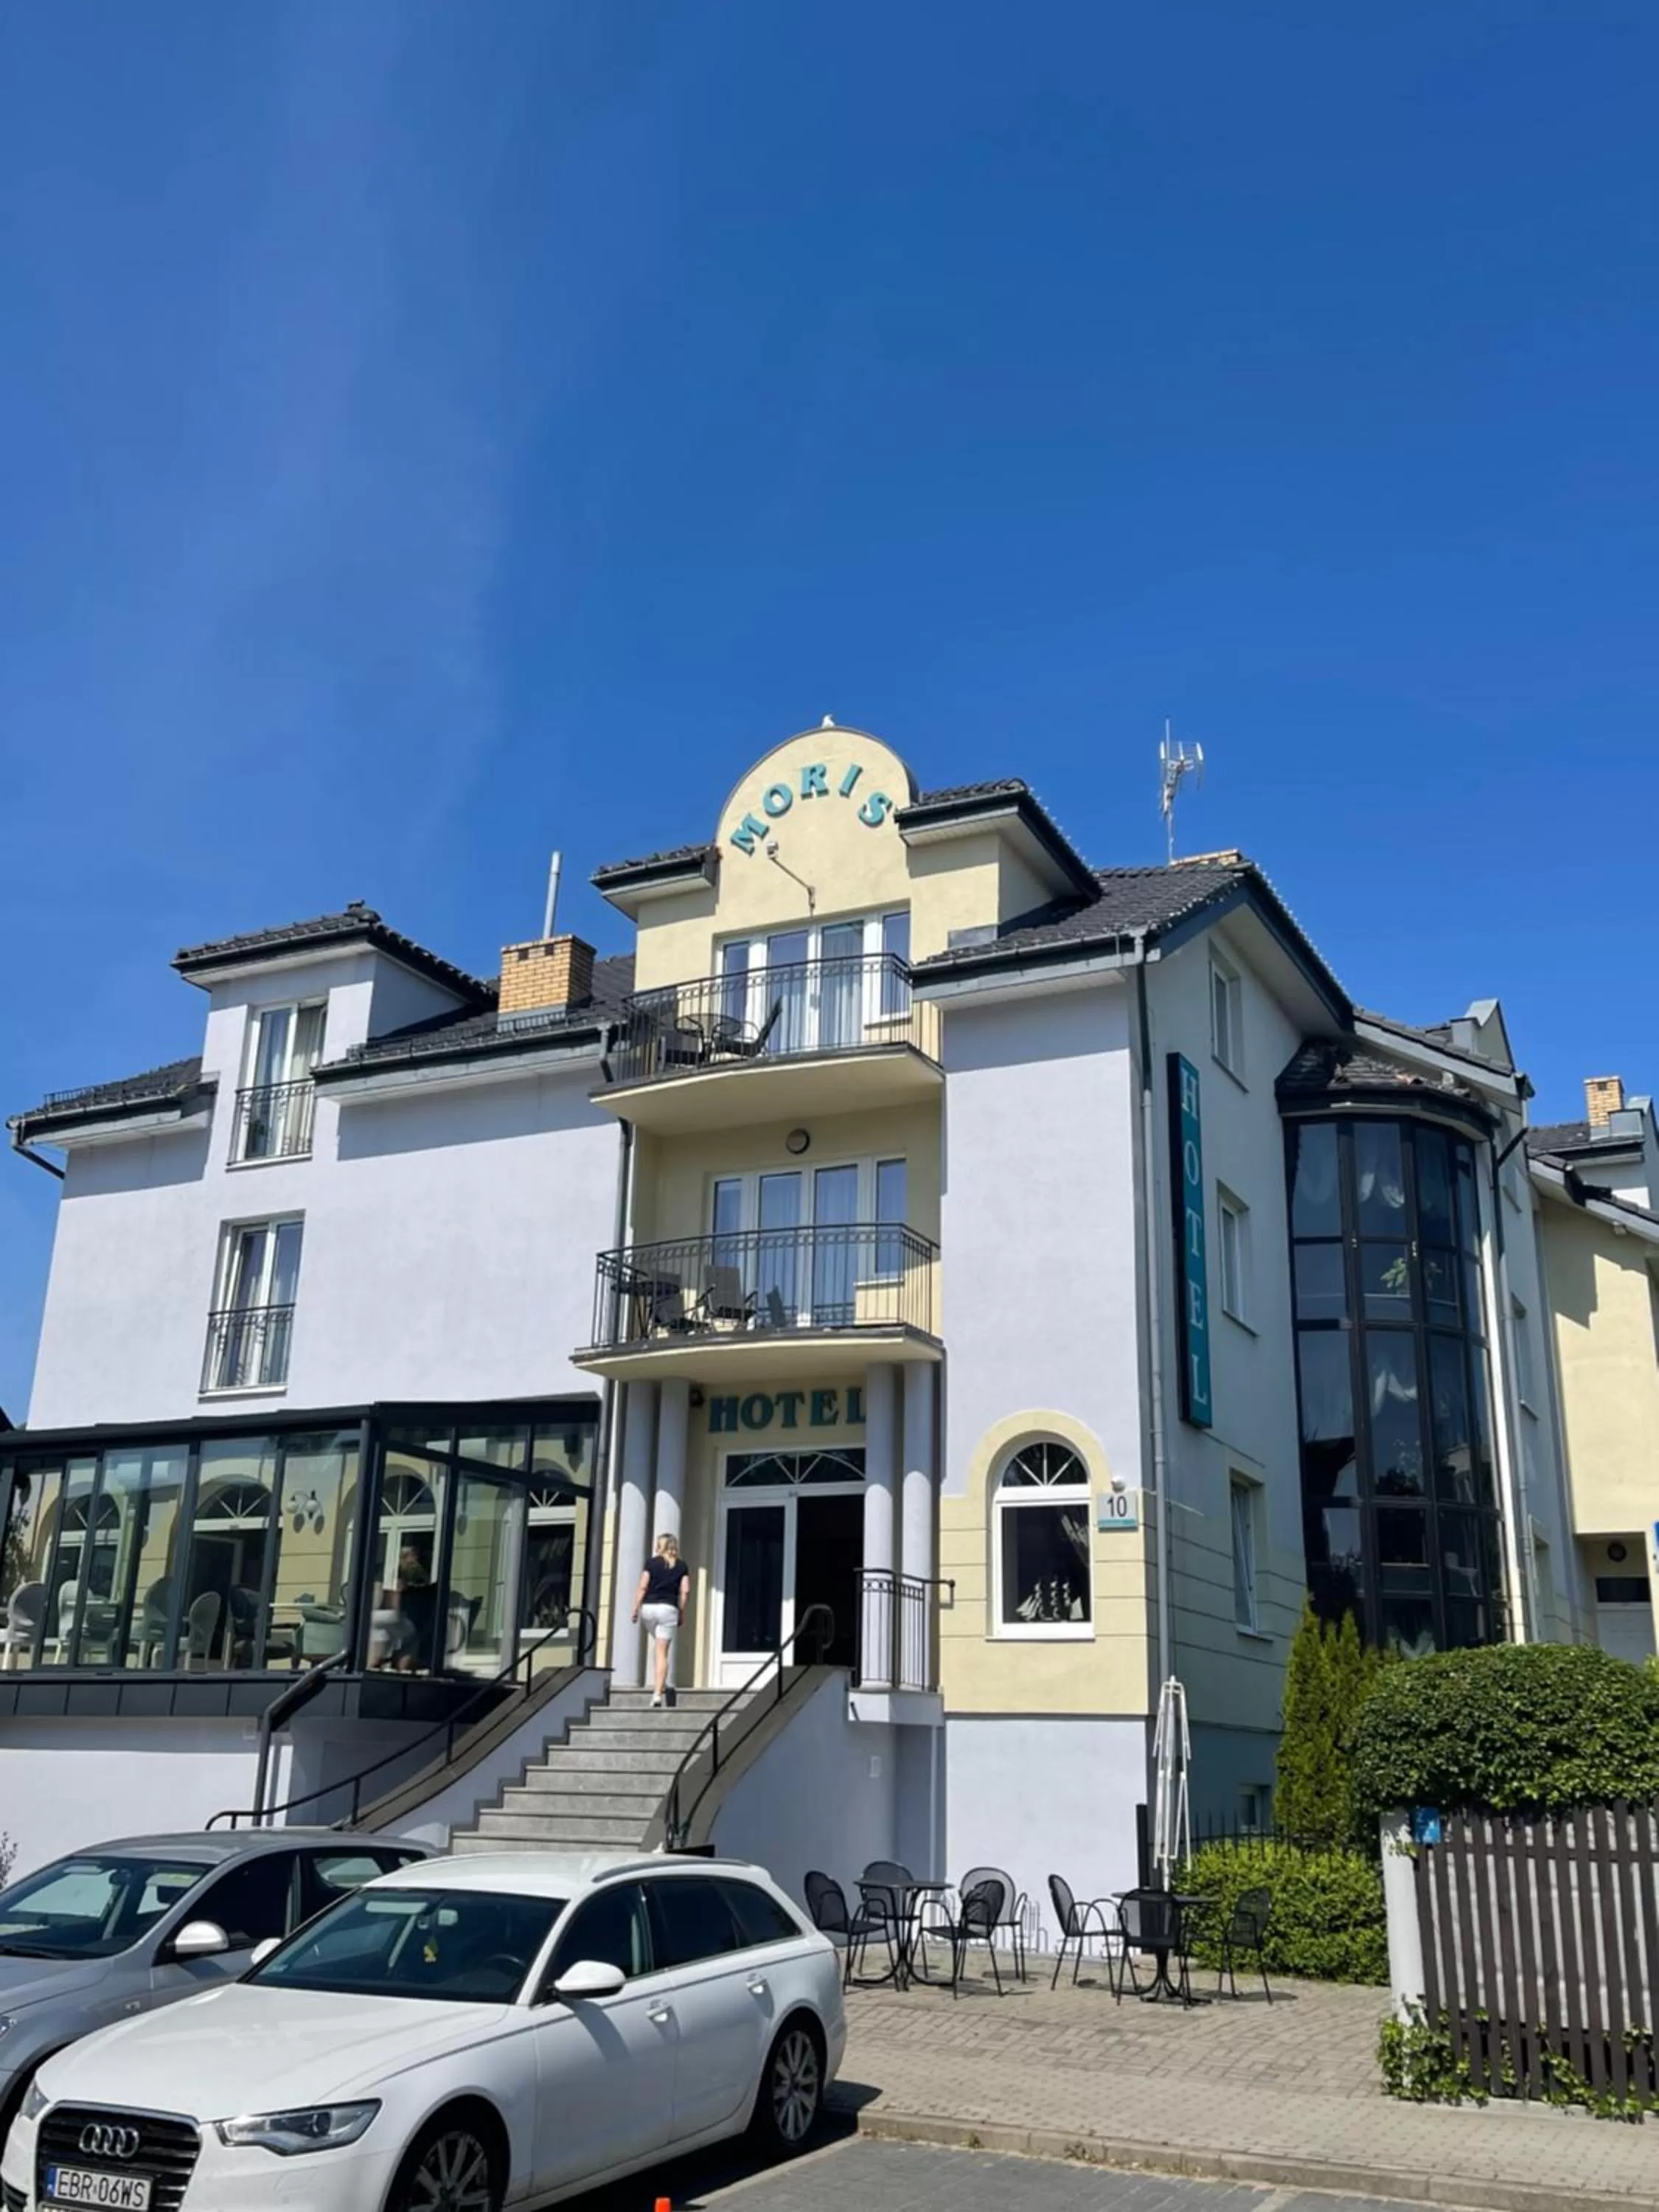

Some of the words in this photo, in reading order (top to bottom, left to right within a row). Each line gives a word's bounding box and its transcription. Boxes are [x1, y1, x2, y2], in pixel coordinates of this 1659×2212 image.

[729, 763, 893, 857] MORIS
[1181, 1065, 1207, 1406] HOTEL
[708, 1387, 866, 1433] HOTEL
[1107, 1495, 1127, 1517] 10
